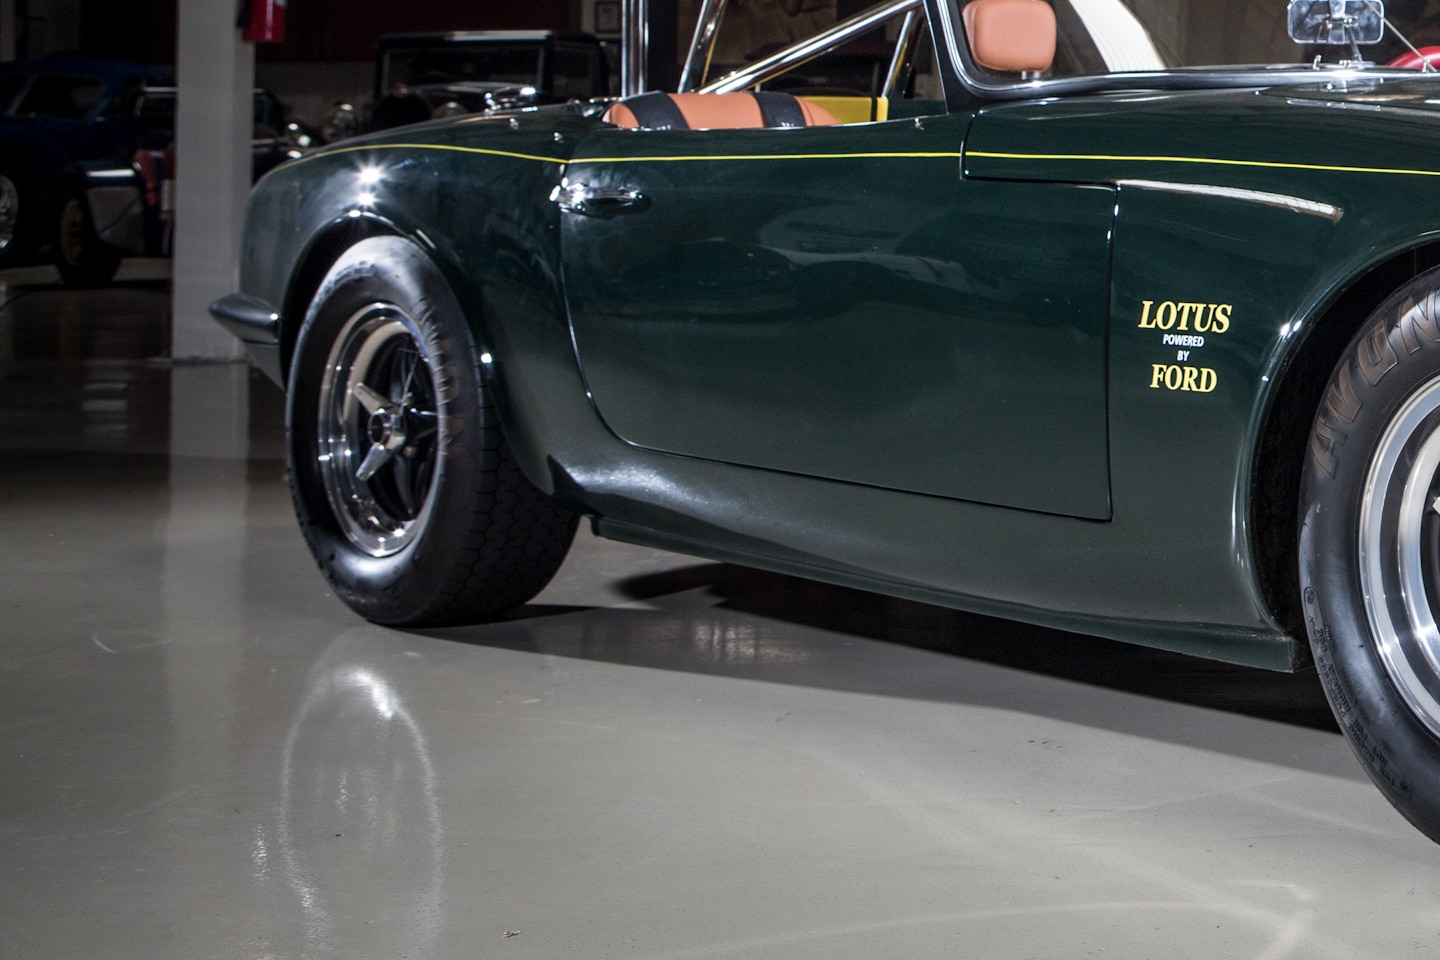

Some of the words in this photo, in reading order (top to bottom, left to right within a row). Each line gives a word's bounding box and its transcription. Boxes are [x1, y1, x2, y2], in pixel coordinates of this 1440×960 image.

[1138, 300, 1233, 333] LOTUS
[1162, 333, 1205, 348] POWERED
[1176, 350, 1190, 362] BY
[1149, 363, 1218, 393] FORD
